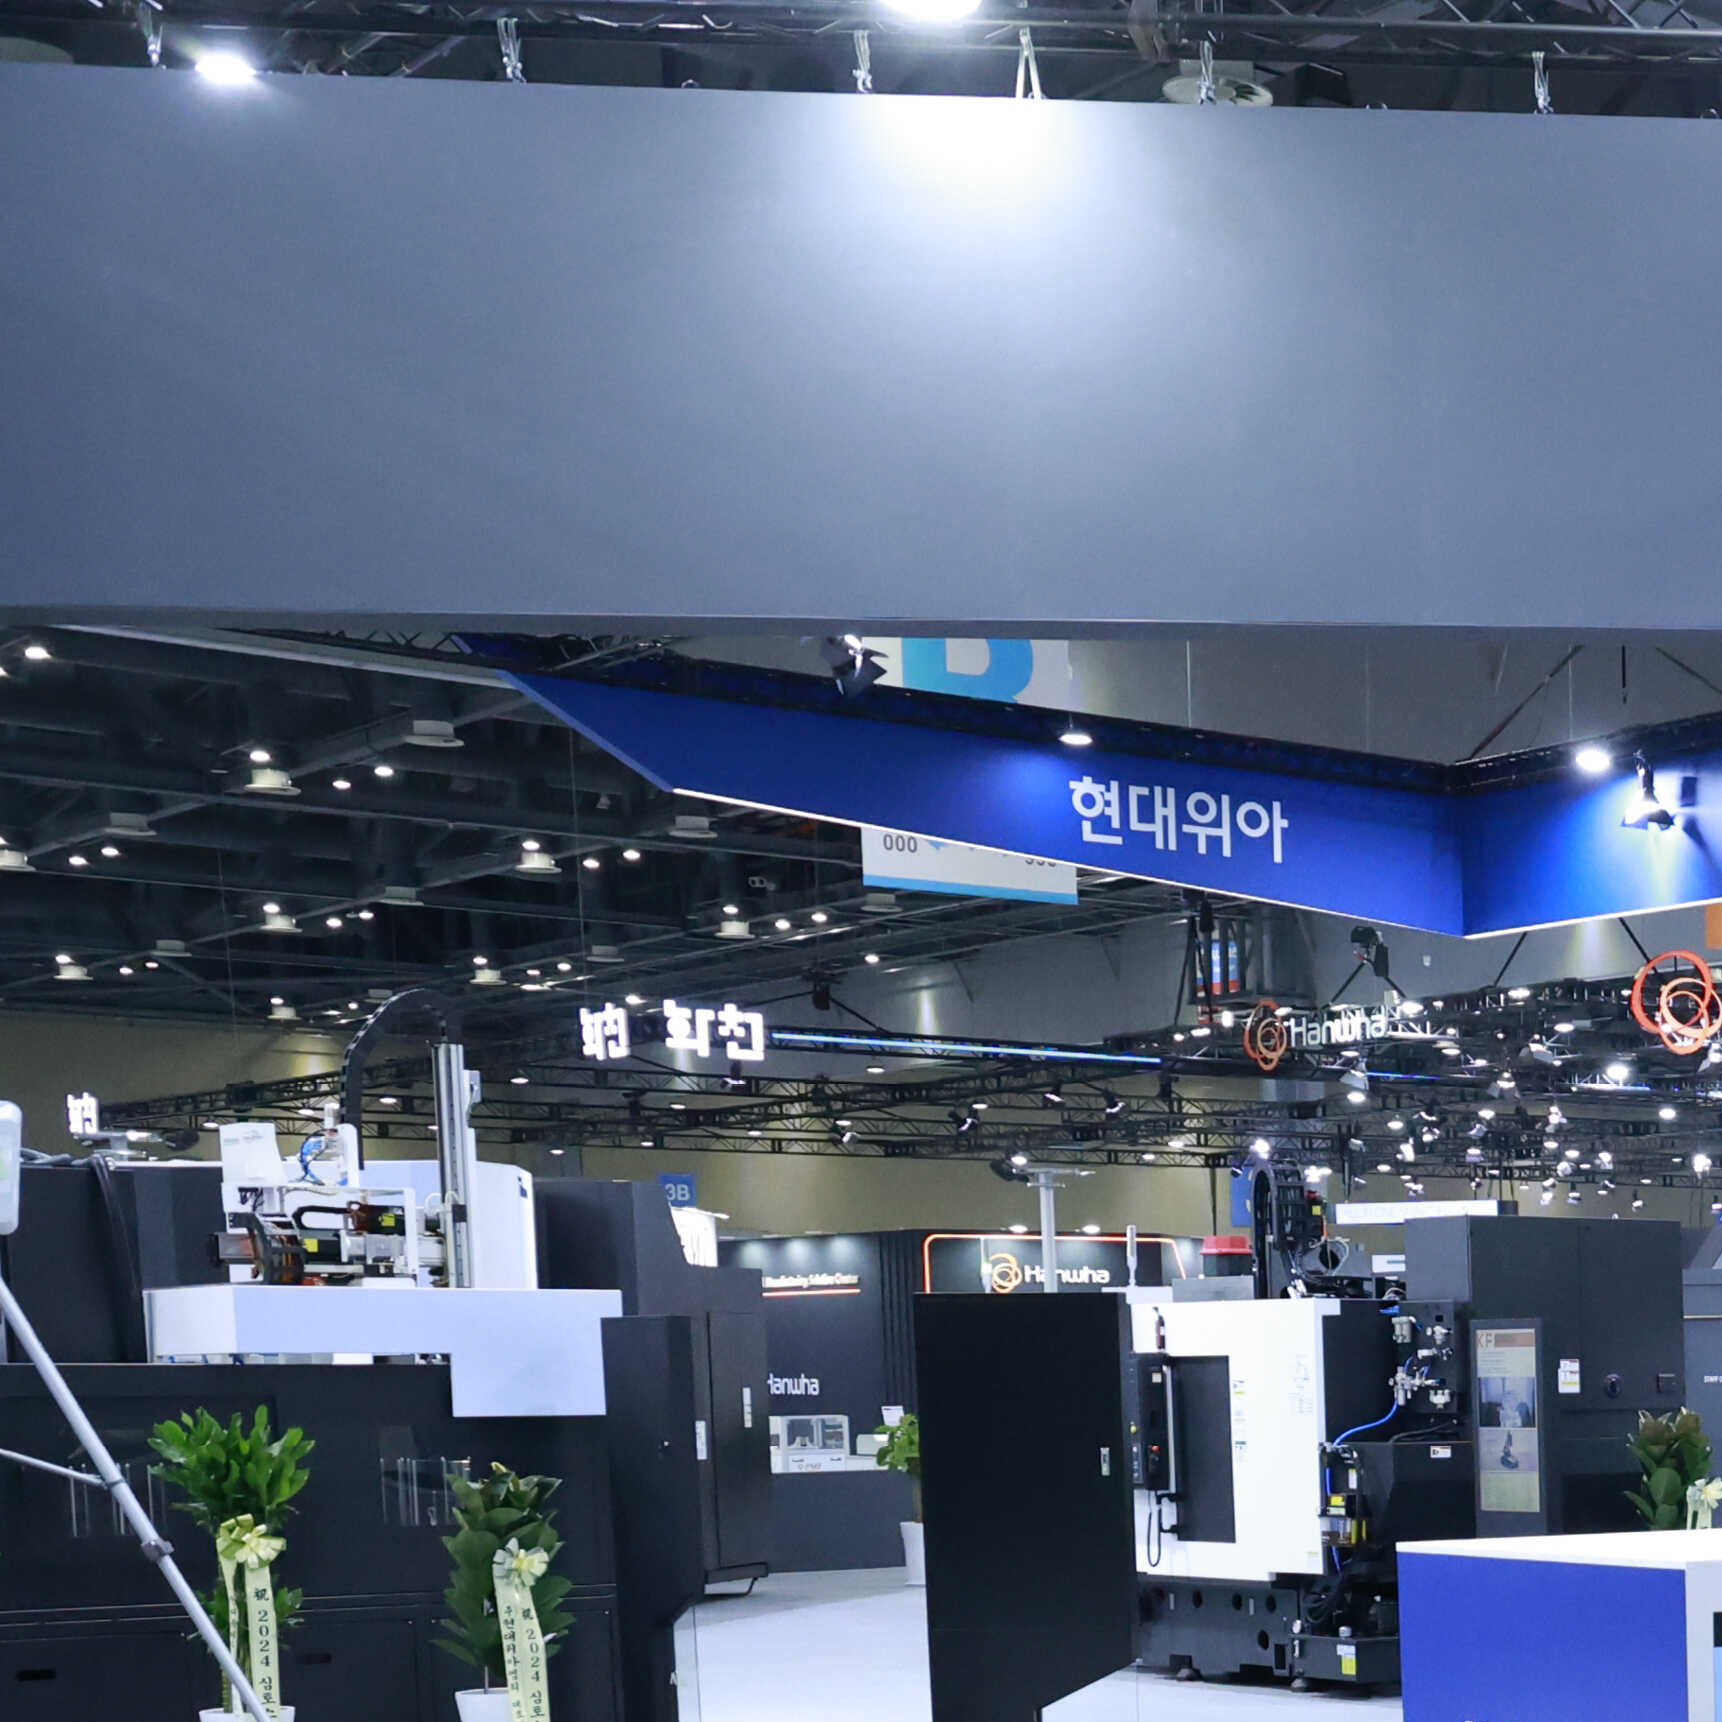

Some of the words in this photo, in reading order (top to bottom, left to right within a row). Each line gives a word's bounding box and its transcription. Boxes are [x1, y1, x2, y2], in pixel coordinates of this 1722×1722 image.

[1068, 775, 1288, 864] 현대위아
[1288, 1004, 1387, 1047] Hanwha
[664, 1181, 692, 1203] 3B
[257, 1609, 271, 1668] 2024
[525, 1628, 541, 1683] 2024
